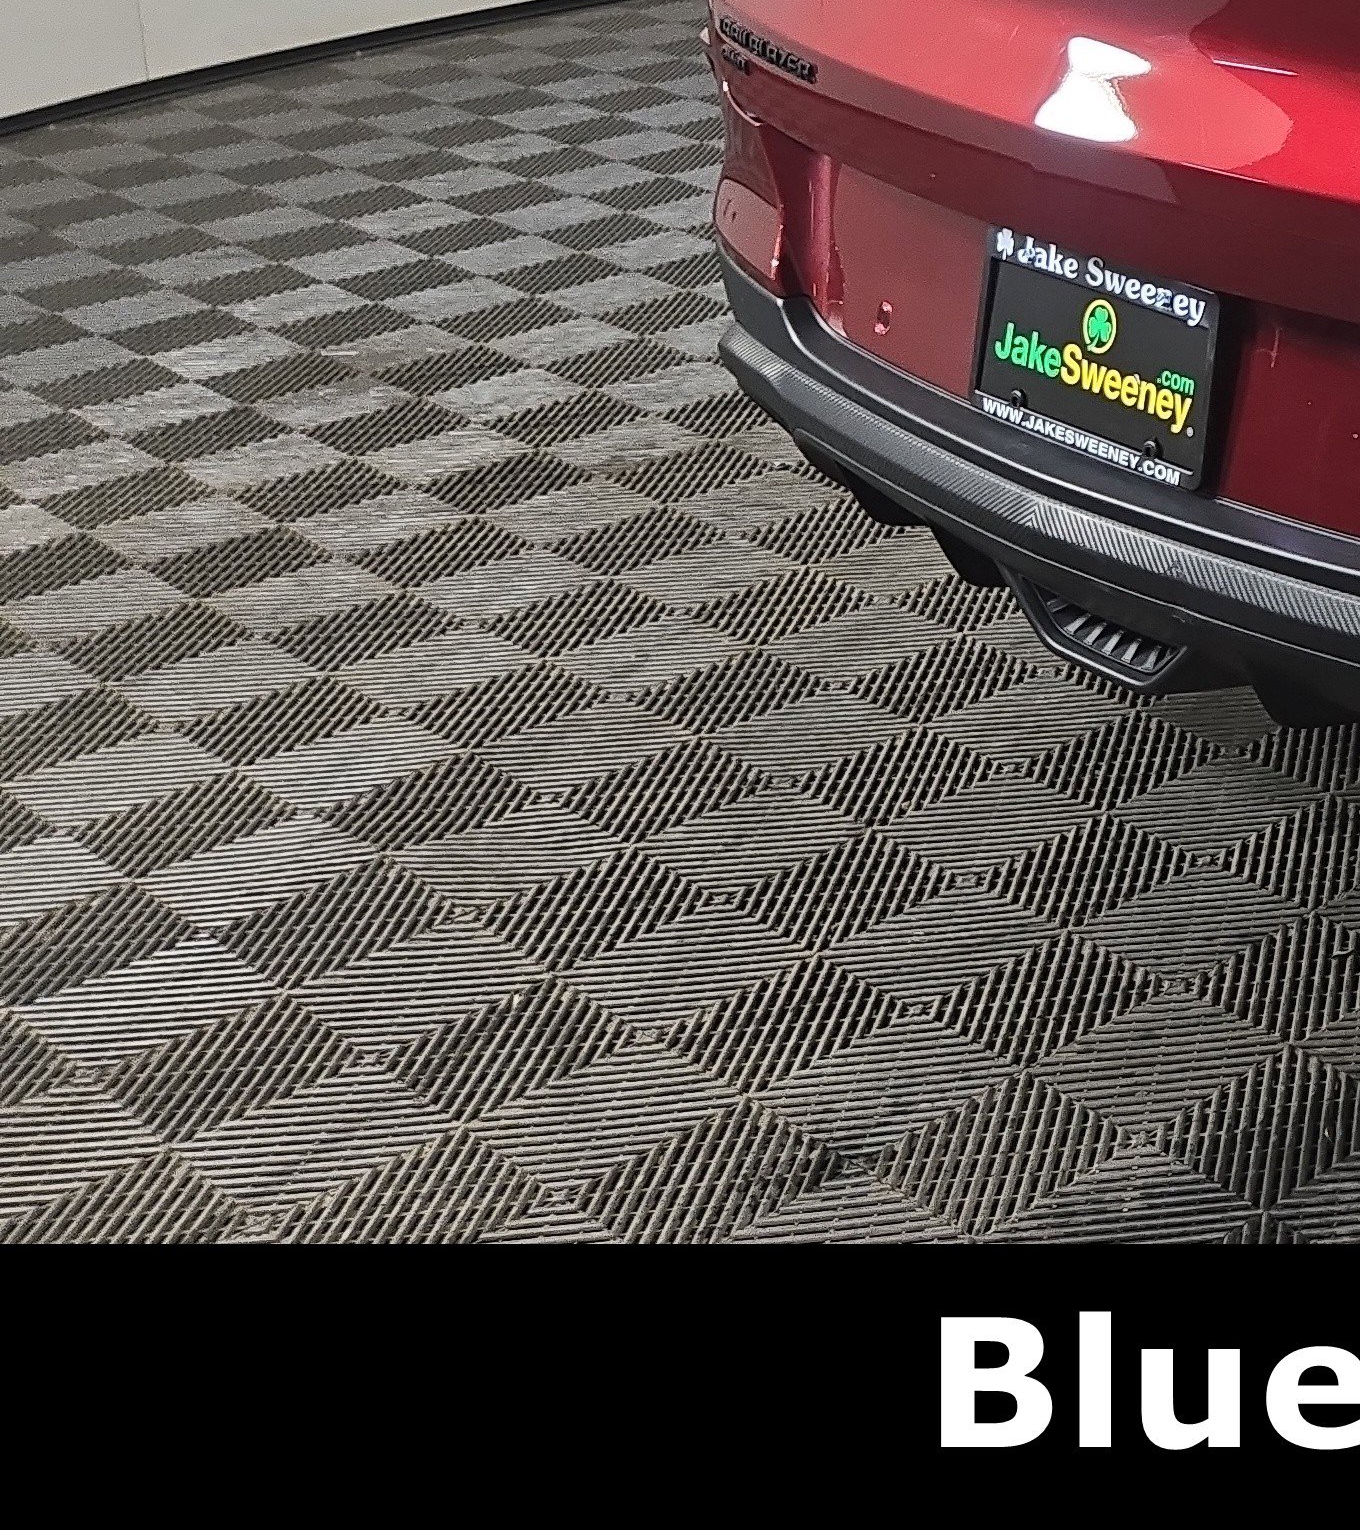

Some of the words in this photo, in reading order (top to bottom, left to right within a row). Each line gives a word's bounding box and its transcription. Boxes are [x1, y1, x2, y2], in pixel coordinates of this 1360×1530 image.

[1017, 235, 1078, 280] Jake
[1084, 256, 1206, 327] Sweeney
[982, 397, 1181, 487] WWW.JAKESWEENEY.COM
